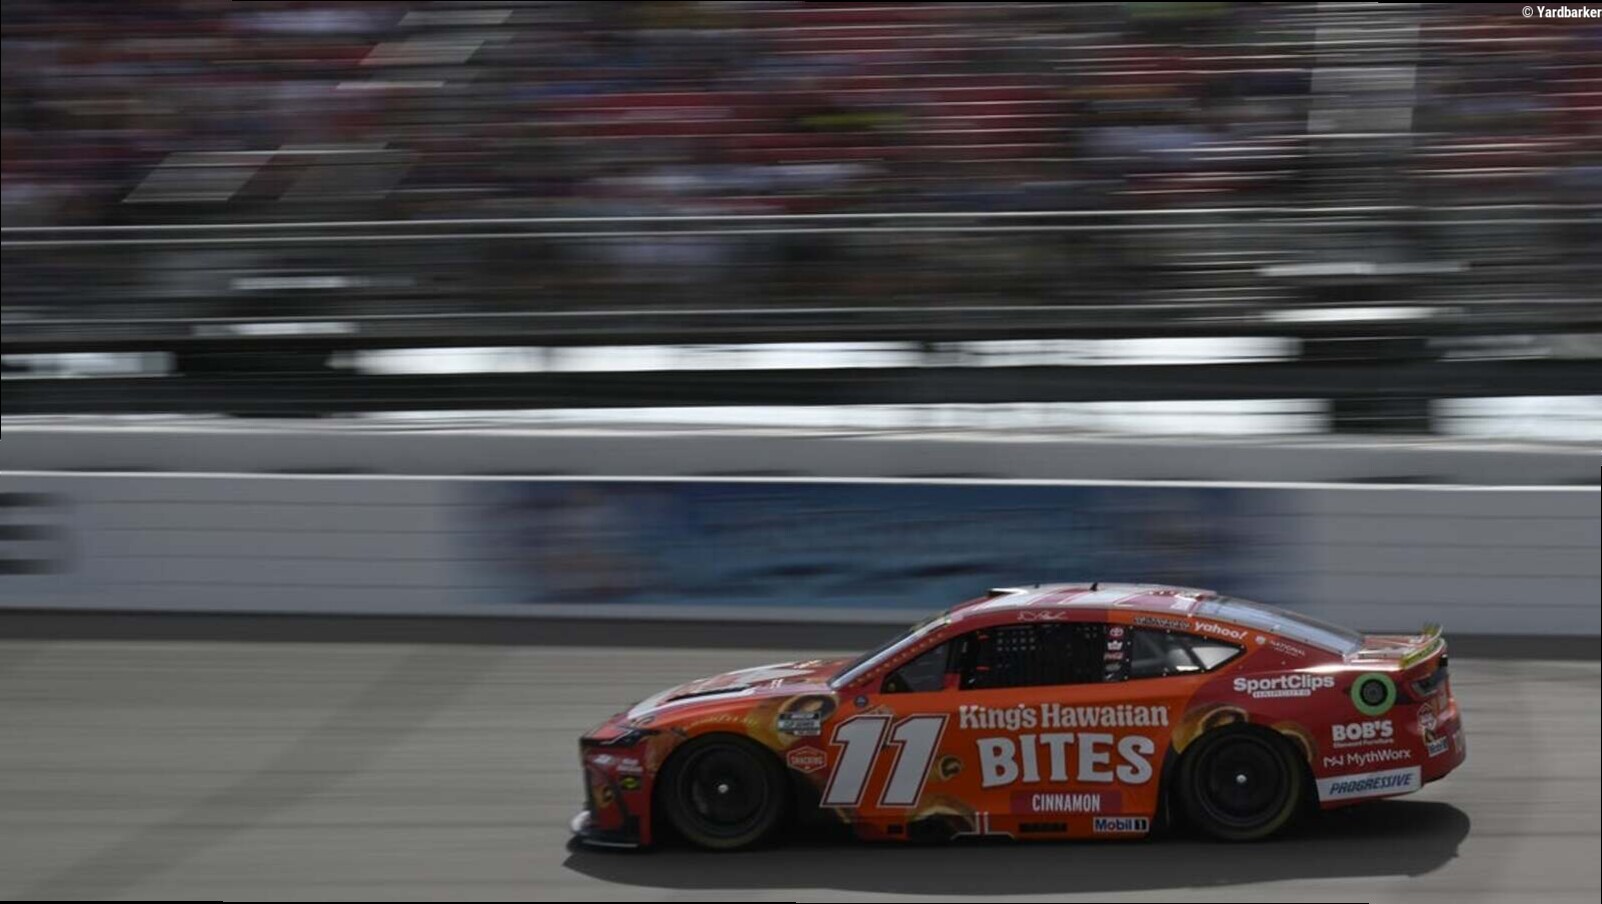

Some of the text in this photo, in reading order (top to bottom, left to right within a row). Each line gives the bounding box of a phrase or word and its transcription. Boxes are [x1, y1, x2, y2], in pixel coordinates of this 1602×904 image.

[1194, 621, 1248, 640] yahoo!
[959, 703, 1169, 730] King's Hawaiian
[1331, 719, 1394, 741] BOB'S
[819, 713, 950, 808] 11
[976, 732, 1155, 788] BITES
[1346, 749, 1412, 767] MythWorx
[1329, 773, 1414, 796] PROGRESSIVE
[1032, 794, 1101, 812] CINNAMON
[1095, 819, 1132, 831] Mobil
